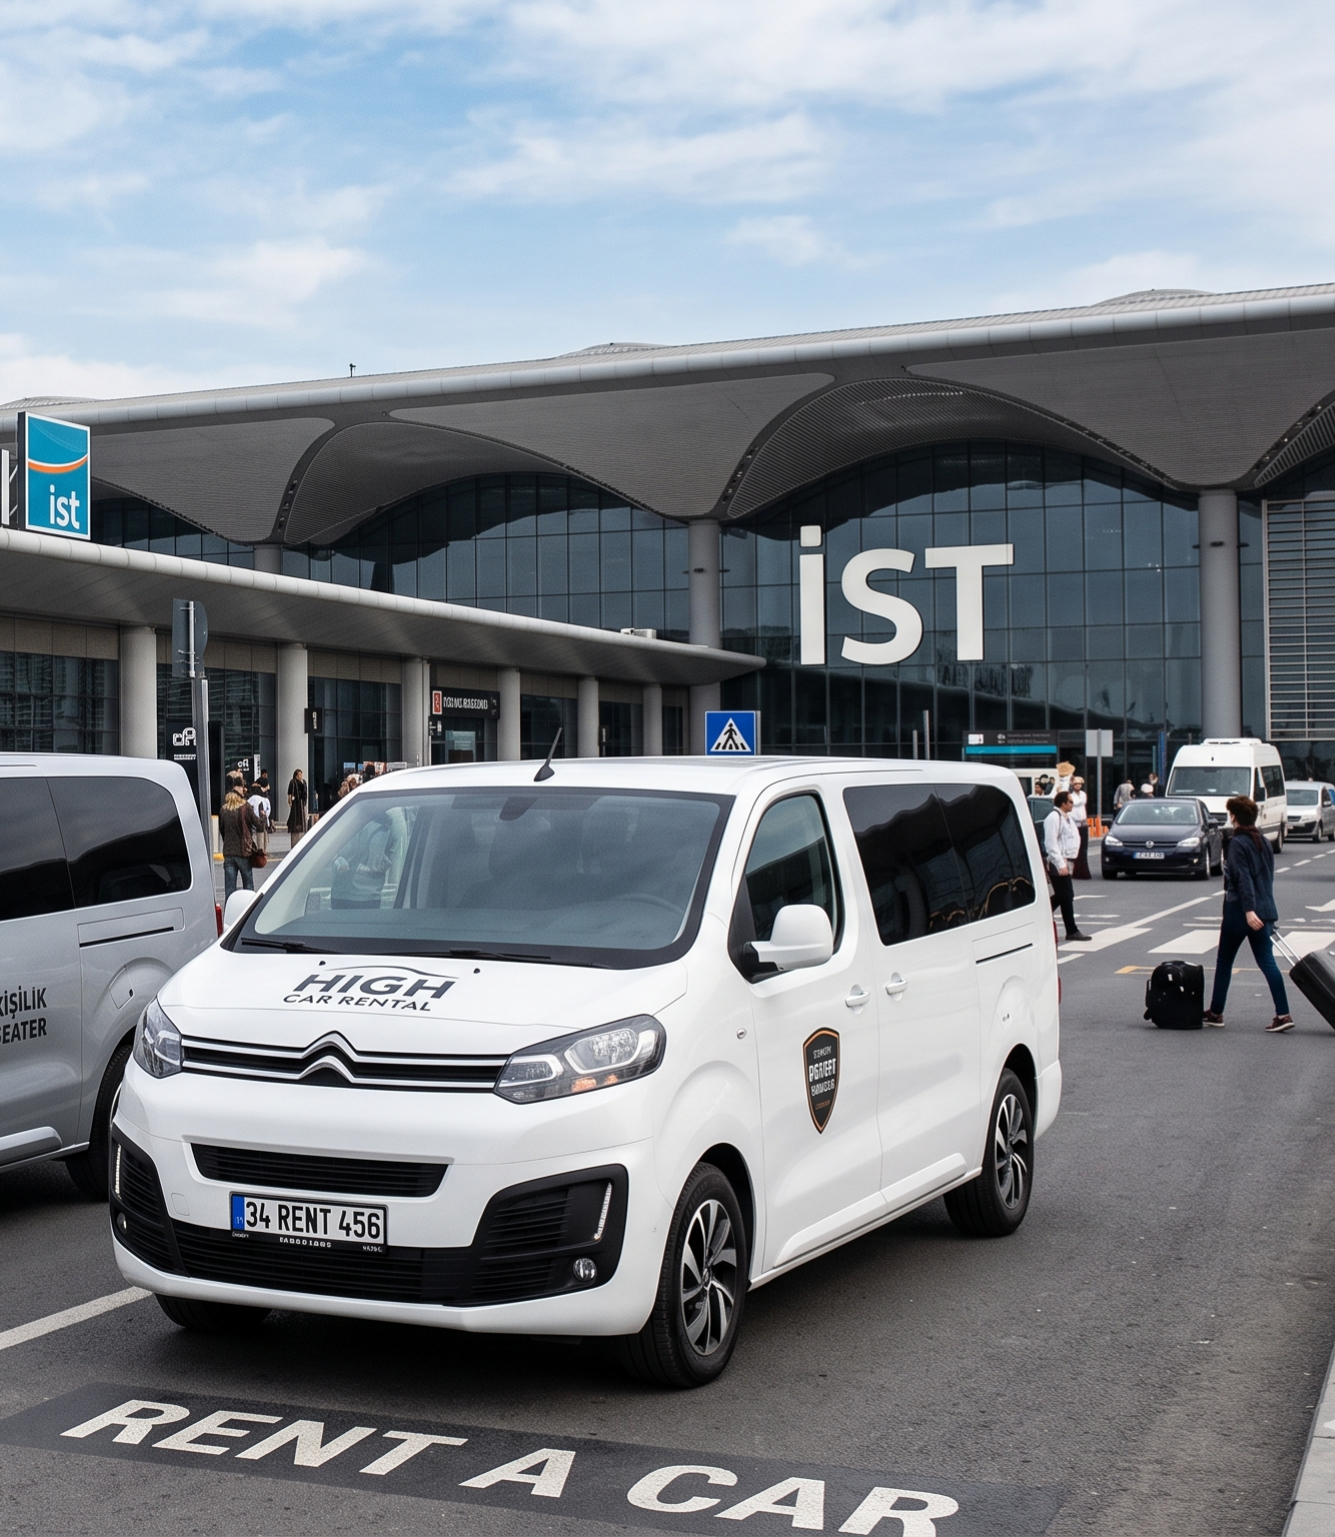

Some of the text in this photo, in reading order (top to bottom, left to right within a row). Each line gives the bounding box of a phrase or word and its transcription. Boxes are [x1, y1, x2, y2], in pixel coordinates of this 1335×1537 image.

[49, 484, 80, 530] ist
[283, 994, 431, 1012] CAR RENTAL
[293, 974, 456, 999] HIGH
[246, 1201, 381, 1240] 34 RENT 456
[60, 1399, 959, 1537] RENT A CAR
